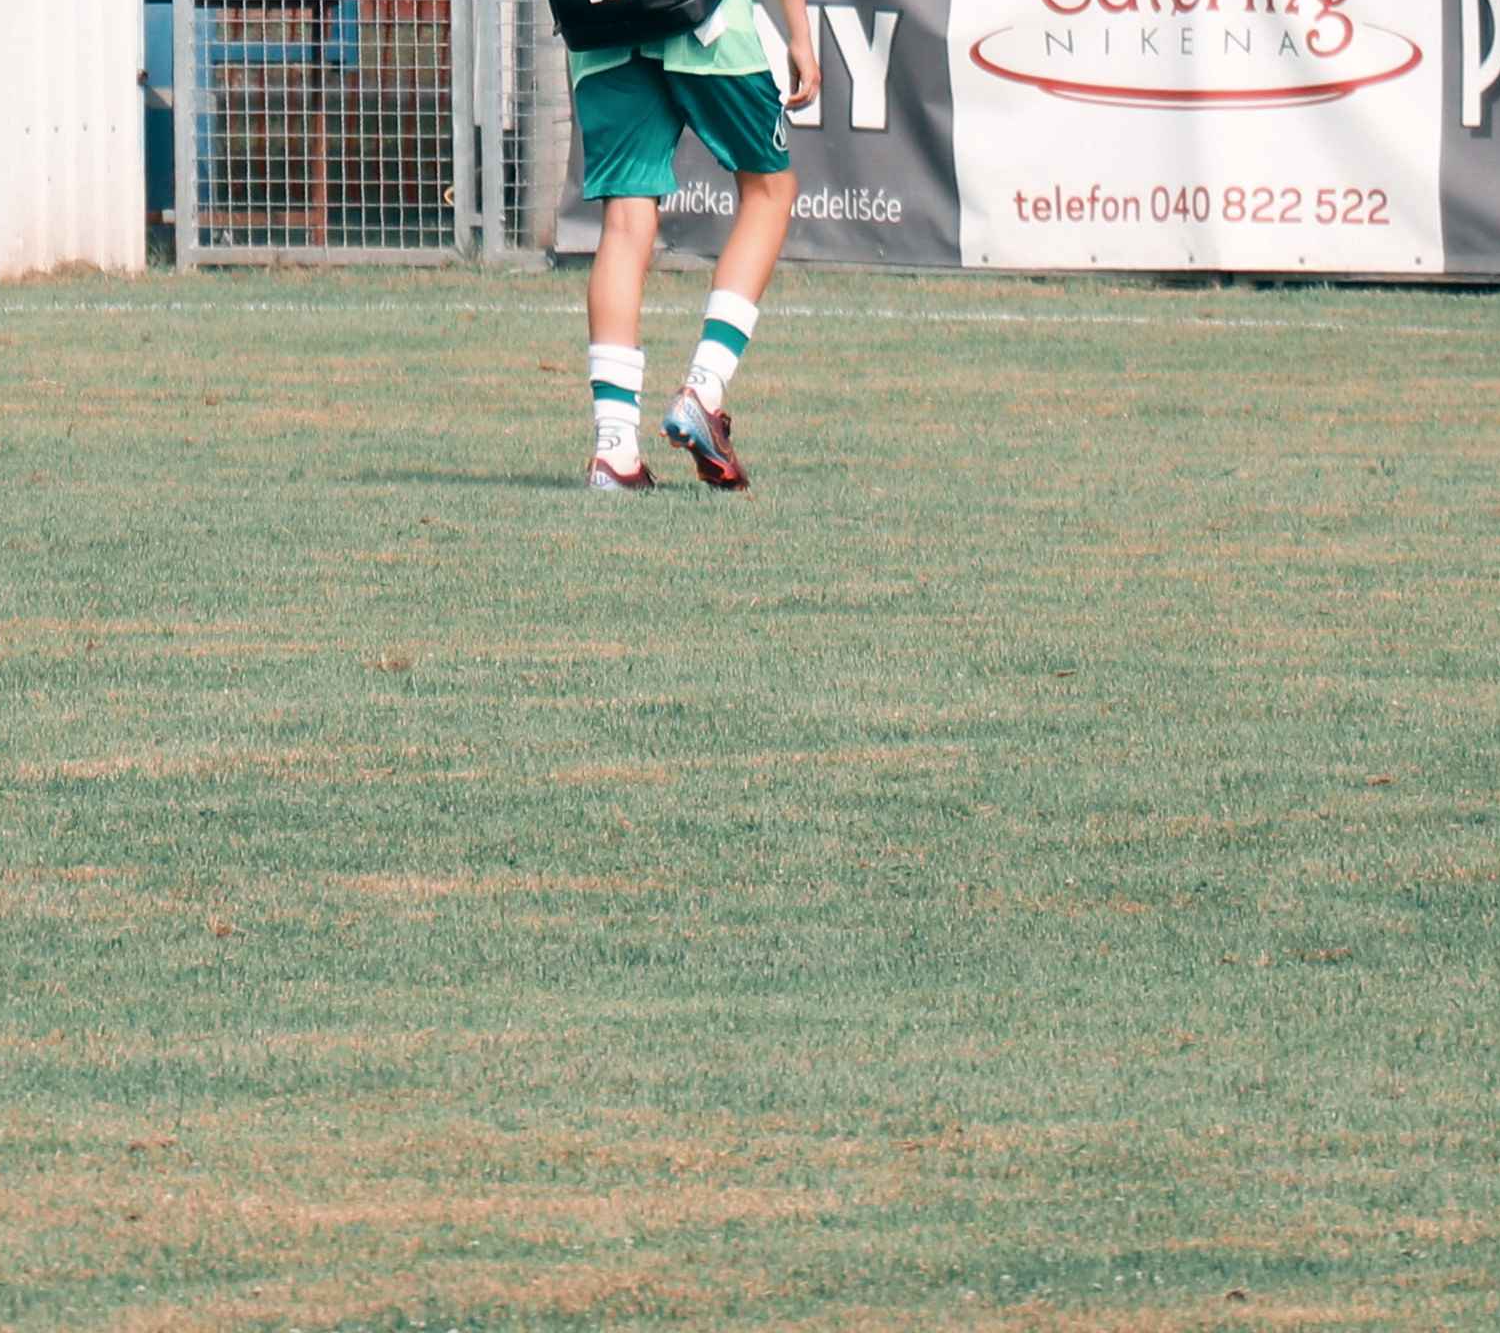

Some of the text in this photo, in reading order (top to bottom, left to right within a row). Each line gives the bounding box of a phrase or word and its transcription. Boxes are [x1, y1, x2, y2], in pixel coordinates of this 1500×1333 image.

[1045, 27, 1300, 57] NIKENA
[658, 181, 735, 216] nička
[1013, 185, 1390, 226] telefon 040 822 522
